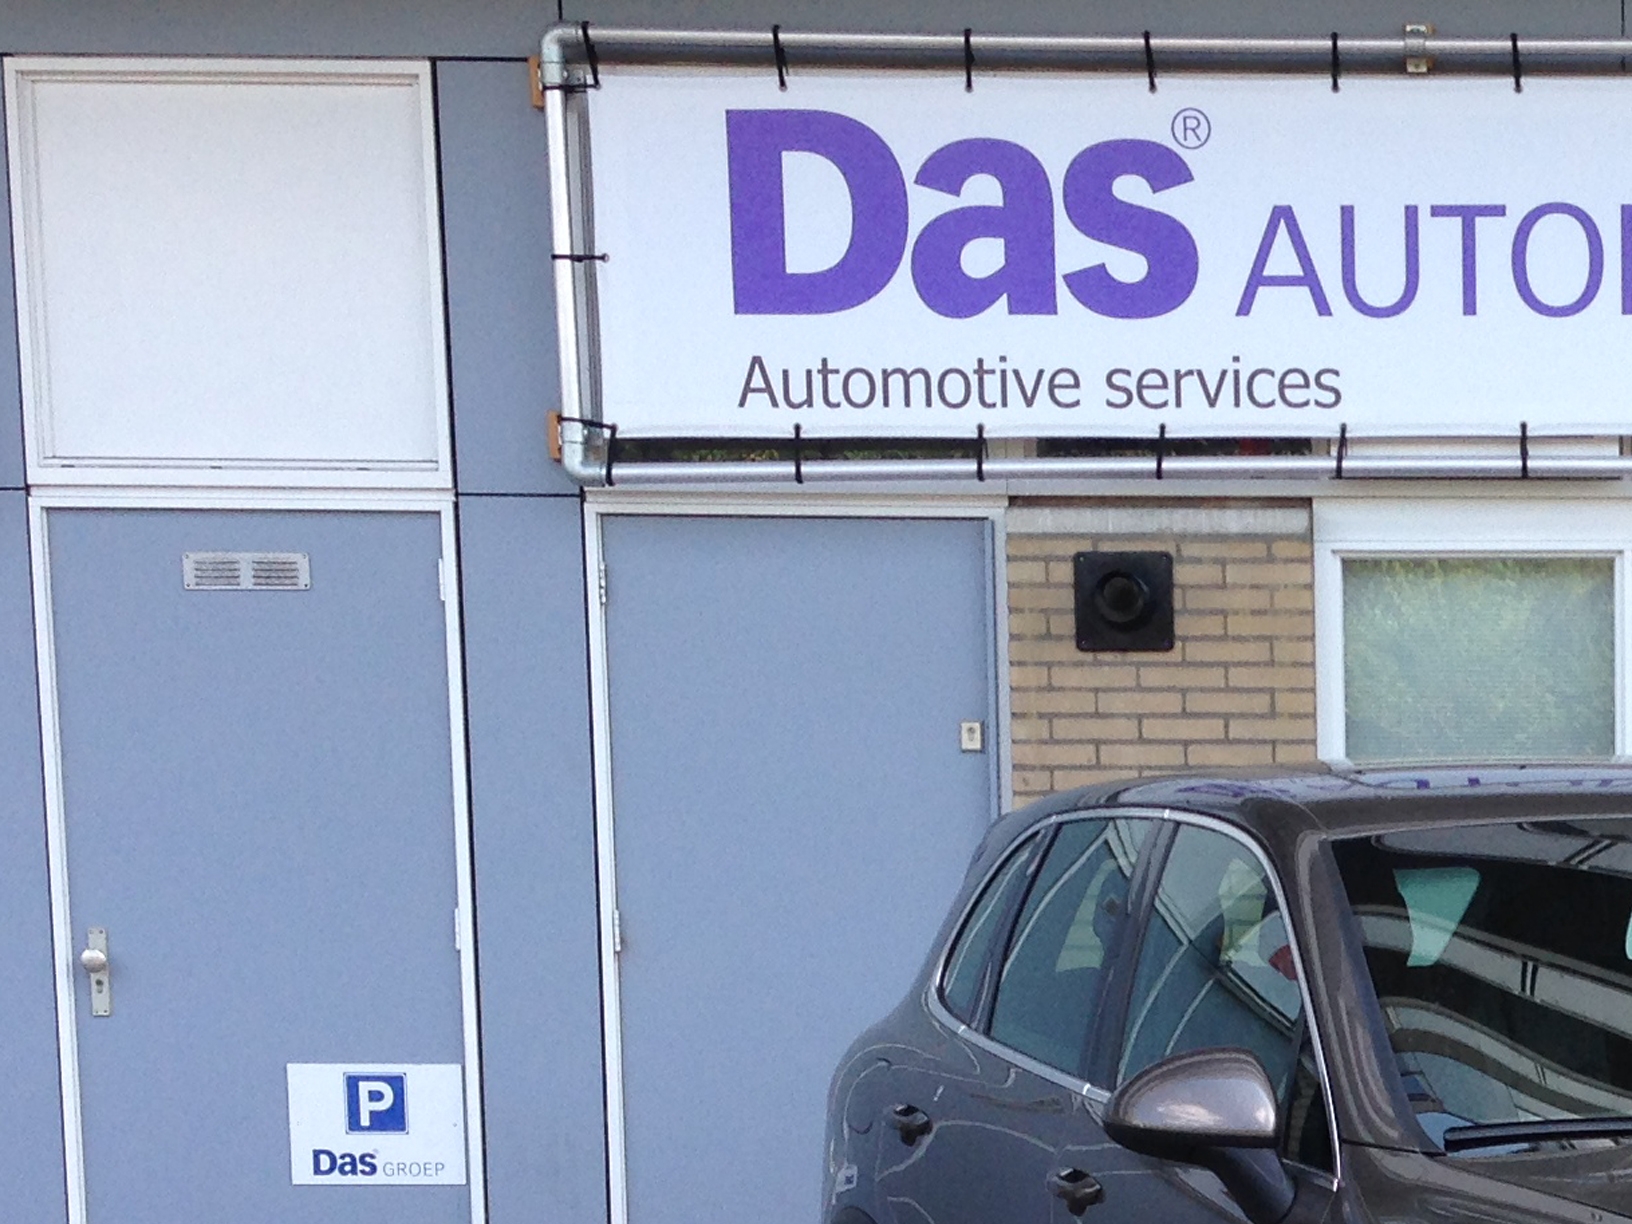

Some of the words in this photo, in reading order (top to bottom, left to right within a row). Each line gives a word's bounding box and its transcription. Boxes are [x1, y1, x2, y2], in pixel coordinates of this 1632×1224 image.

[738, 356, 1081, 410] Automotive
[1106, 356, 1342, 410] services
[358, 1080, 394, 1127] P
[312, 1149, 378, 1177] Das
[382, 1162, 445, 1177] GROEP
